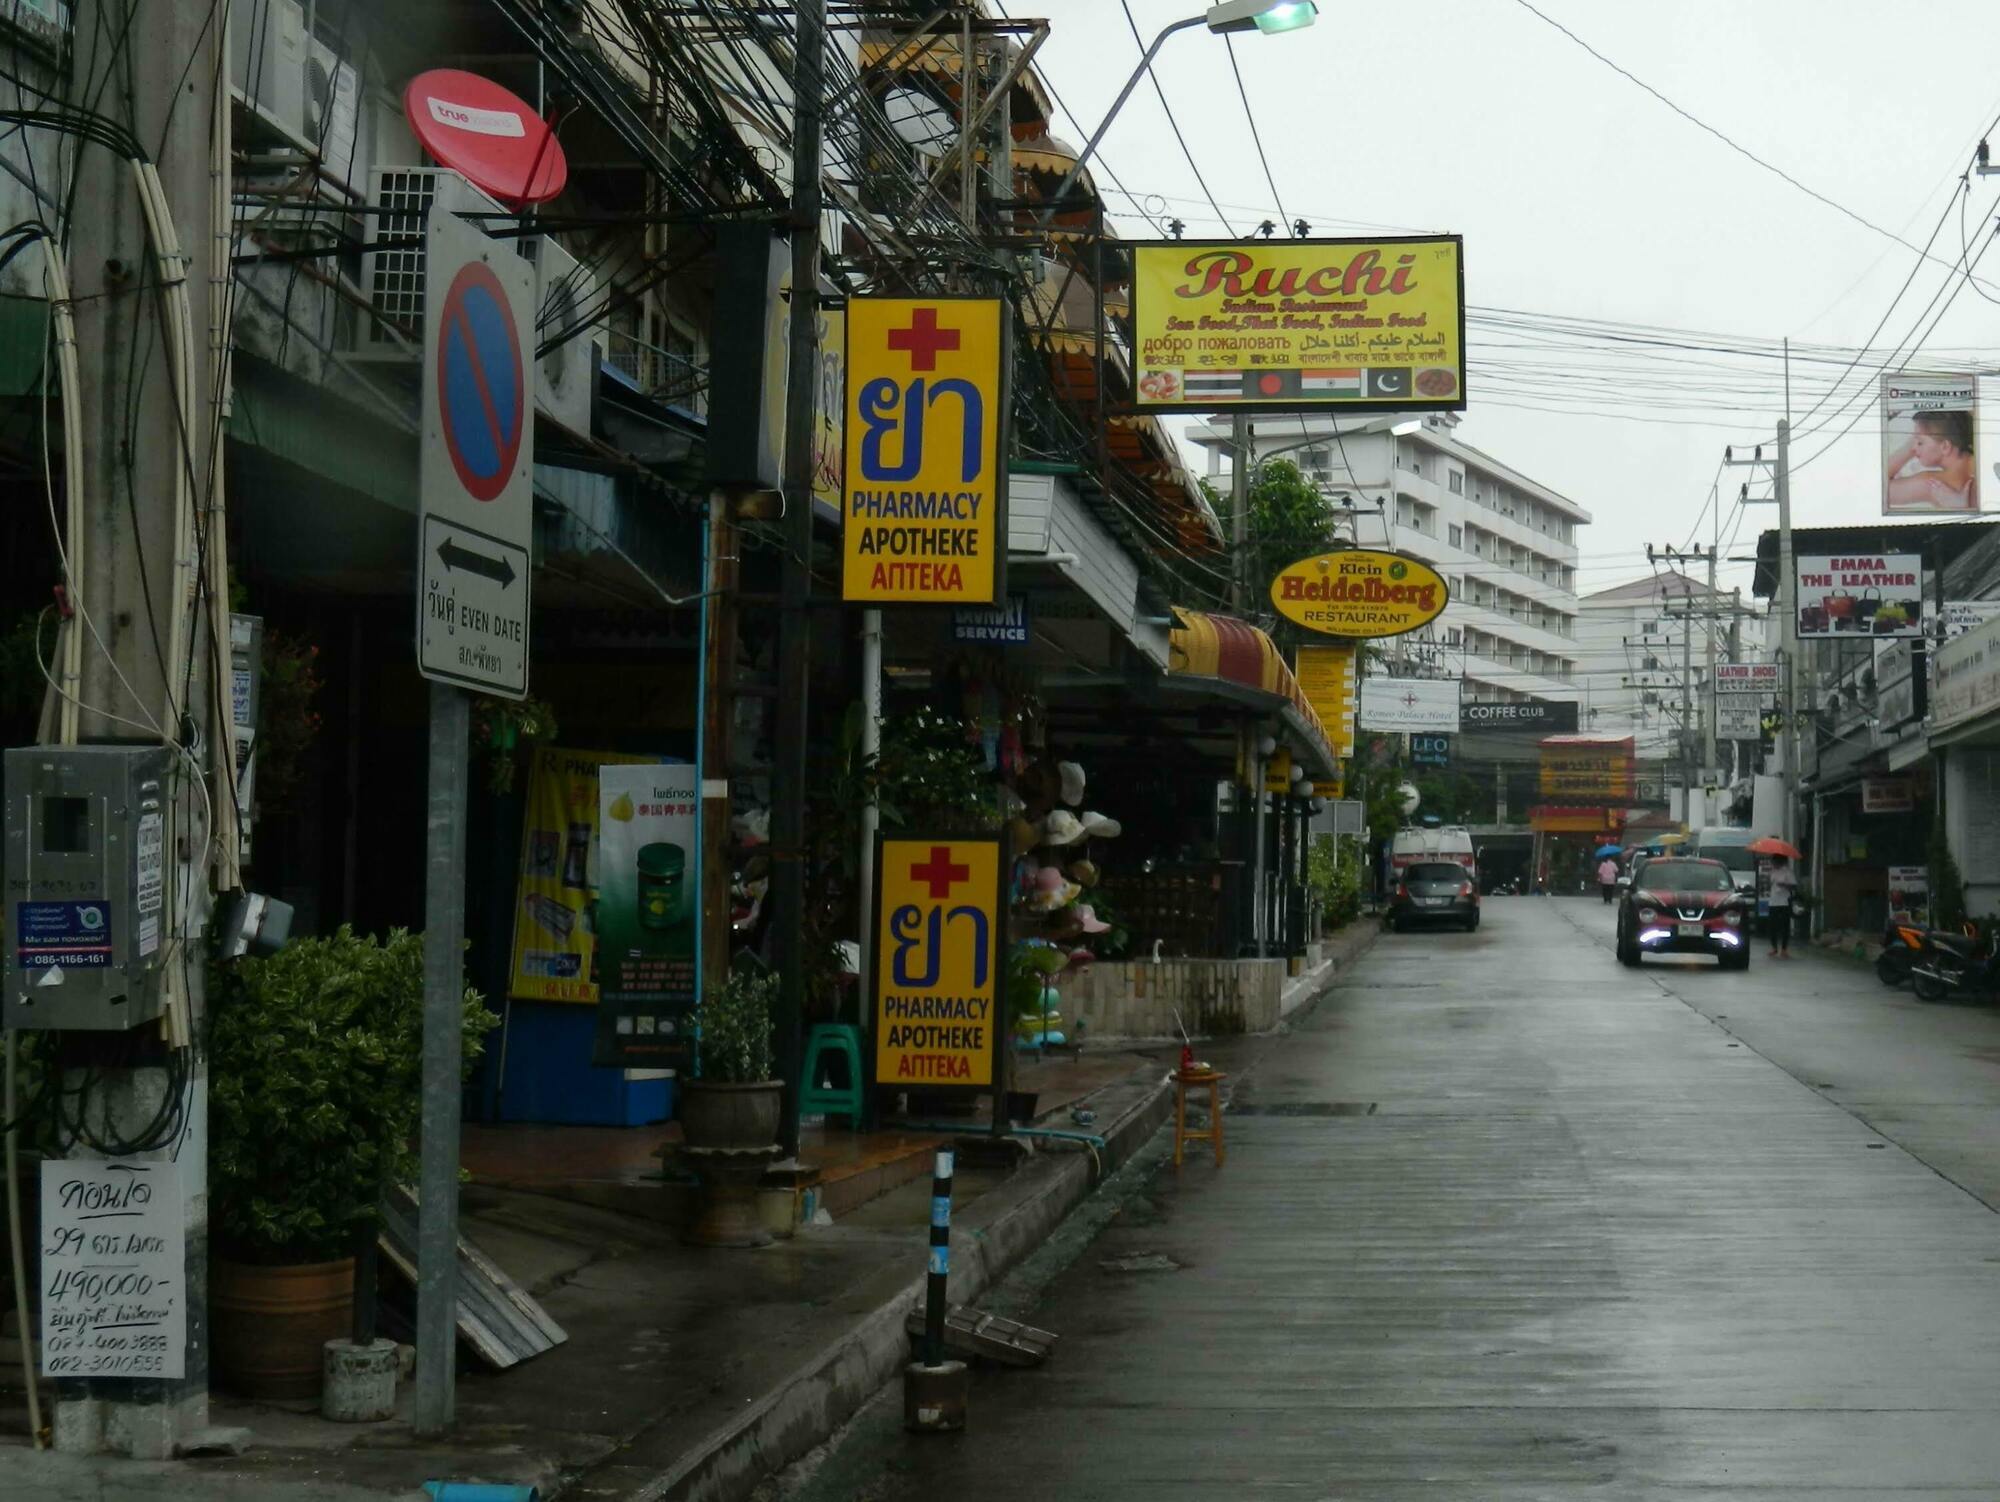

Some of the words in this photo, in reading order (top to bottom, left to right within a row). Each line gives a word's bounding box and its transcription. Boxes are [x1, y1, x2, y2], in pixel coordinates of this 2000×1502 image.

[437, 105, 469, 123] true
[1174, 248, 1418, 299] Ruchi
[1143, 333, 1193, 353] добро
[1197, 336, 1292, 350] пожаловать
[858, 377, 983, 483] ยา
[851, 490, 982, 520] PHARMACY
[857, 526, 978, 557] APOTHEKE
[1338, 563, 1382, 575] Klein
[1830, 558, 1887, 571] EMMA
[870, 562, 964, 592] АПТЕКА
[1800, 574, 1833, 587] THE
[1841, 573, 1917, 587] LEATHER
[1280, 575, 1437, 612] Heidelberg
[428, 579, 455, 636] วันคู่
[461, 605, 489, 634] EVEN
[494, 615, 522, 643] DATE
[1304, 610, 1411, 624] RESTAURANT
[955, 627, 1026, 640] SERVICE
[1468, 706, 1517, 719] COFFEE
[1518, 706, 1545, 718] CLUB
[1413, 737, 1448, 751] LEO
[890, 904, 989, 989] ยา
[34, 954, 105, 965] 086-1166-161
[884, 996, 990, 1020] PHARMACY
[887, 1025, 984, 1050] APOTHEKE
[897, 1054, 971, 1079] АПТЕКА
[45, 1227, 86, 1256] 29
